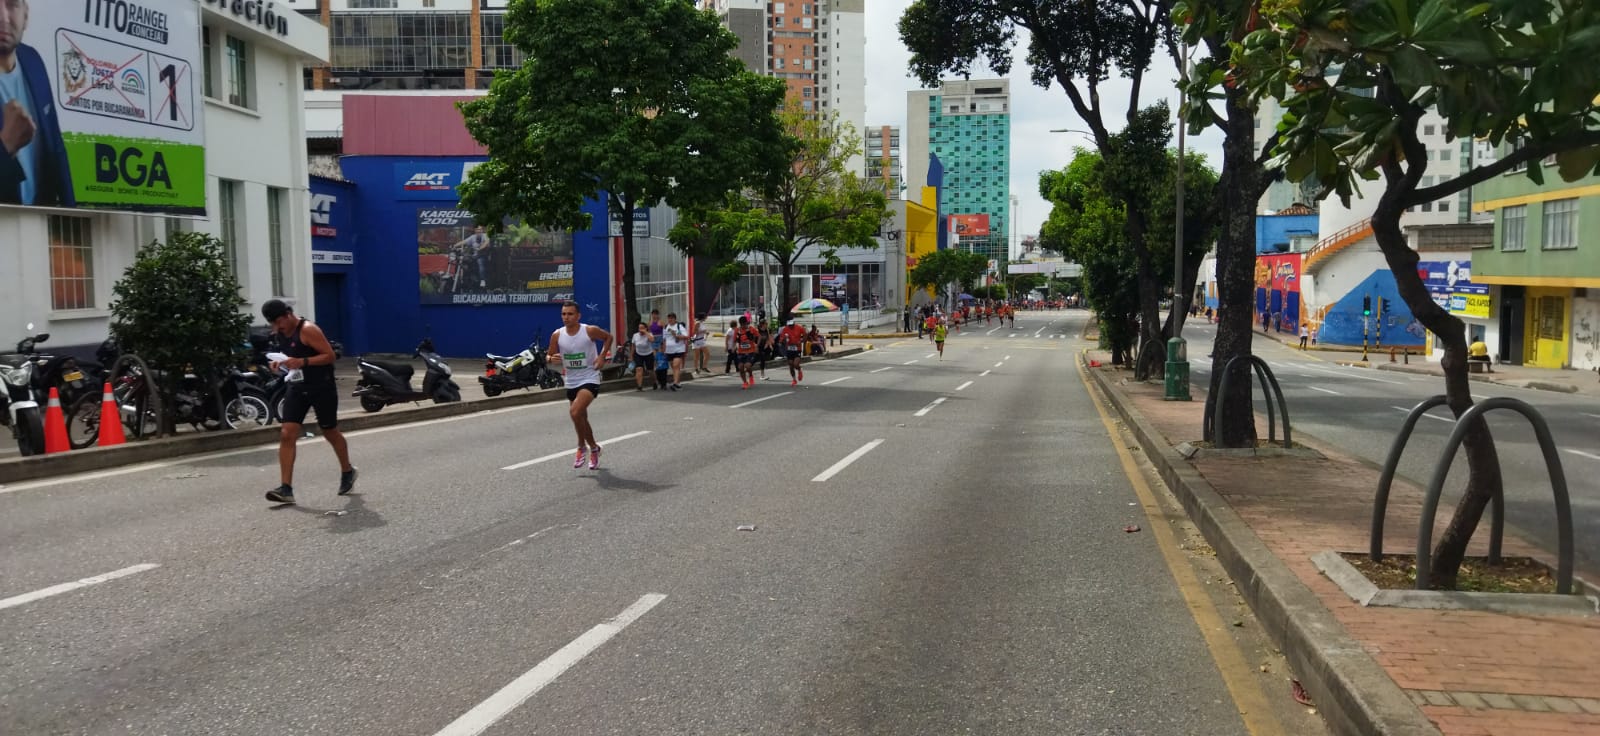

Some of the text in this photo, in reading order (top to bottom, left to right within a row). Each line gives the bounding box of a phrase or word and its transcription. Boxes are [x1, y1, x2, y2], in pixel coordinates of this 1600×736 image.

[129, 3, 169, 31] RANGEL
[131, 25, 165, 43] CONCEJAL
[159, 64, 178, 121] 1
[92, 99, 104, 112] POR
[94, 143, 173, 190] BGA
[404, 173, 450, 185] AKT
[420, 210, 475, 218] KARGUE
[453, 294, 507, 303] BUCARAMANGA
[509, 294, 549, 303] TERRITORIO
